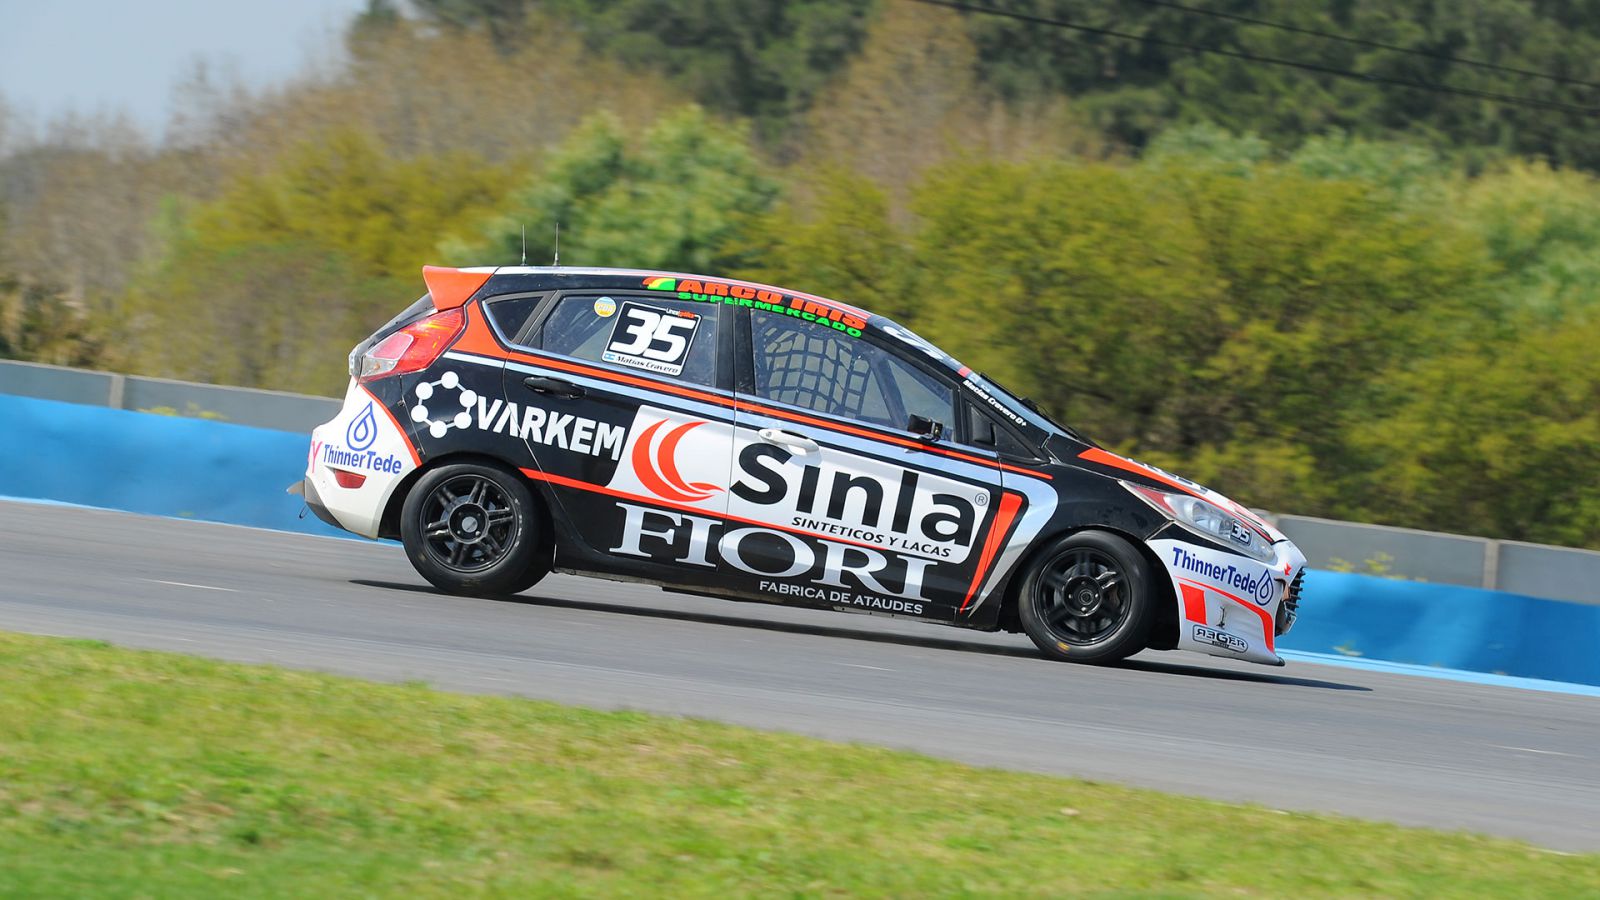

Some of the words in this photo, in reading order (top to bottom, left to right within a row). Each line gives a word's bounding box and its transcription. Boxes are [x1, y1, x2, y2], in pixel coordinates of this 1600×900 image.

[677, 279, 783, 304] ARCO
[790, 297, 867, 330] IRIS
[677, 292, 862, 338] SUPERMERCADO
[609, 307, 697, 362] 35
[477, 395, 627, 461] VARKEM
[323, 444, 403, 475] ThinnerTede
[729, 442, 976, 547] Sinla
[608, 501, 938, 602] FIORI
[791, 516, 885, 544] SINTETICOS
[888, 536, 898, 546] Y
[902, 540, 952, 557] LACAS
[1231, 522, 1251, 543] 35
[1172, 547, 1257, 595] ThinnerTede
[759, 580, 826, 600] FABRICA
[829, 591, 851, 604] DE
[853, 595, 924, 615] ATAUDES
